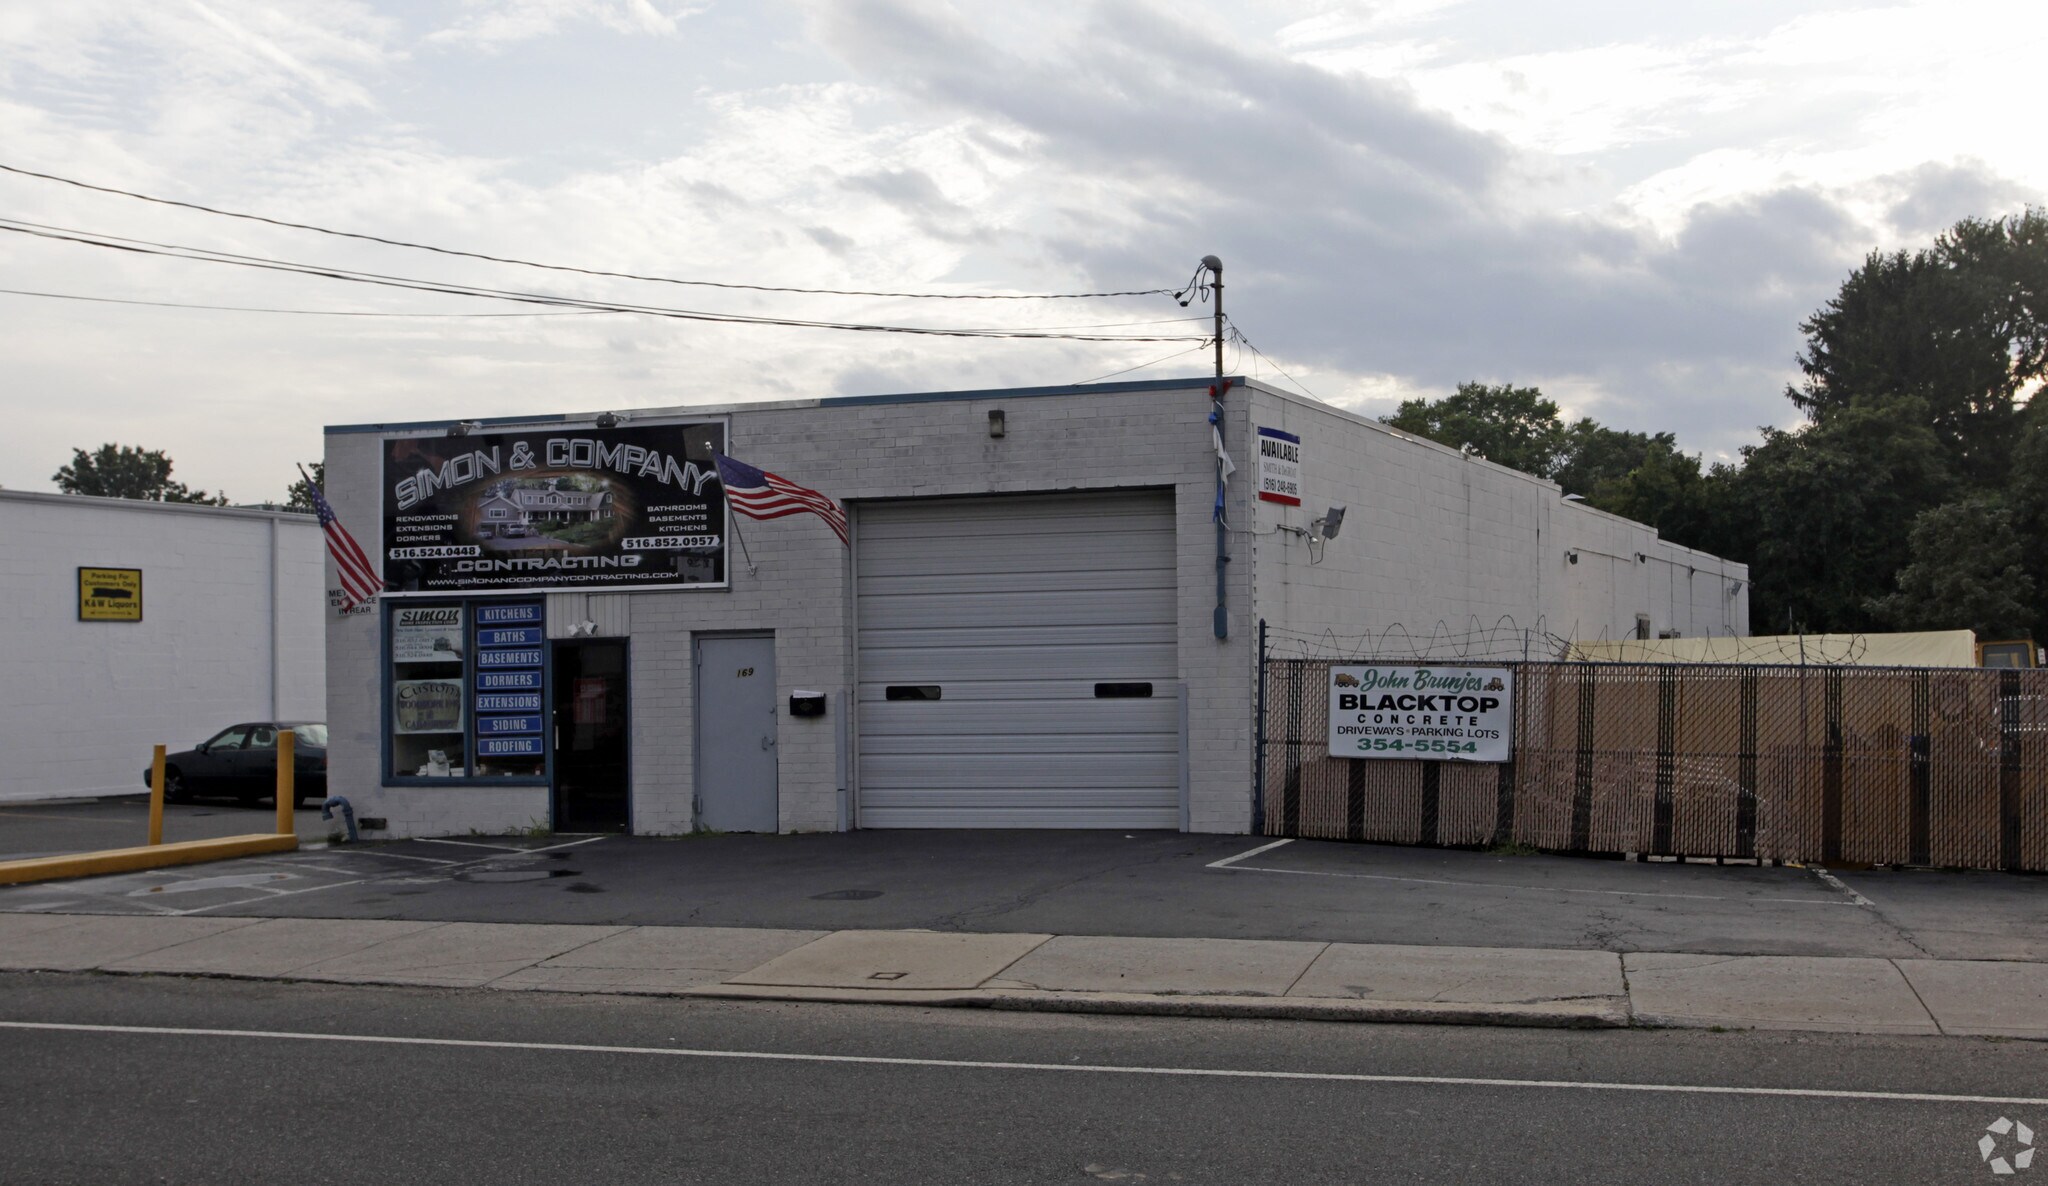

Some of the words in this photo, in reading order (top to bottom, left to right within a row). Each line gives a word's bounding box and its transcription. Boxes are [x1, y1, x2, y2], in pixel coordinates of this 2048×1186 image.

[1261, 439, 1299, 464] AVAILABLE
[394, 446, 501, 511] SIMON
[509, 440, 537, 471] &
[546, 438, 719, 497] COMPANY
[1263, 477, 1277, 491] (516)
[647, 503, 708, 513] BATHROOMS
[395, 514, 459, 523] RENOVATIONS
[648, 514, 708, 522] BASEMENTS
[395, 524, 453, 532] EXTENSIONS
[658, 524, 708, 532] KITCHENS
[396, 534, 441, 542] DORMERS
[626, 536, 715, 548] 516.852.0957
[393, 546, 477, 558] 516.524.0448
[457, 554, 641, 573] CONTRACTING
[91, 572, 117, 580] Parking
[122, 580, 137, 588] Only
[108, 599, 137, 609] Liquors
[349, 606, 372, 614] REAR
[400, 609, 460, 622] SIMON
[485, 608, 533, 620] KITCHENS
[494, 631, 526, 643] BATHS
[481, 652, 540, 664] BASEMENTS
[736, 667, 754, 678] 169
[485, 674, 533, 686] DORMERS
[1360, 668, 1409, 692] John
[1413, 669, 1483, 694] Brunjes
[478, 696, 539, 708] EXTENSIONS
[1339, 694, 1500, 713] BLACKTOP
[492, 719, 527, 731] SIDING
[1357, 713, 1478, 726] CONCRETE
[1337, 726, 1405, 736] DRIVEWAYS
[1411, 727, 1464, 738] PARKING
[1467, 729, 1500, 739] LOTS
[488, 740, 532, 752] ROOFING
[1357, 738, 1477, 754] 354-5554
